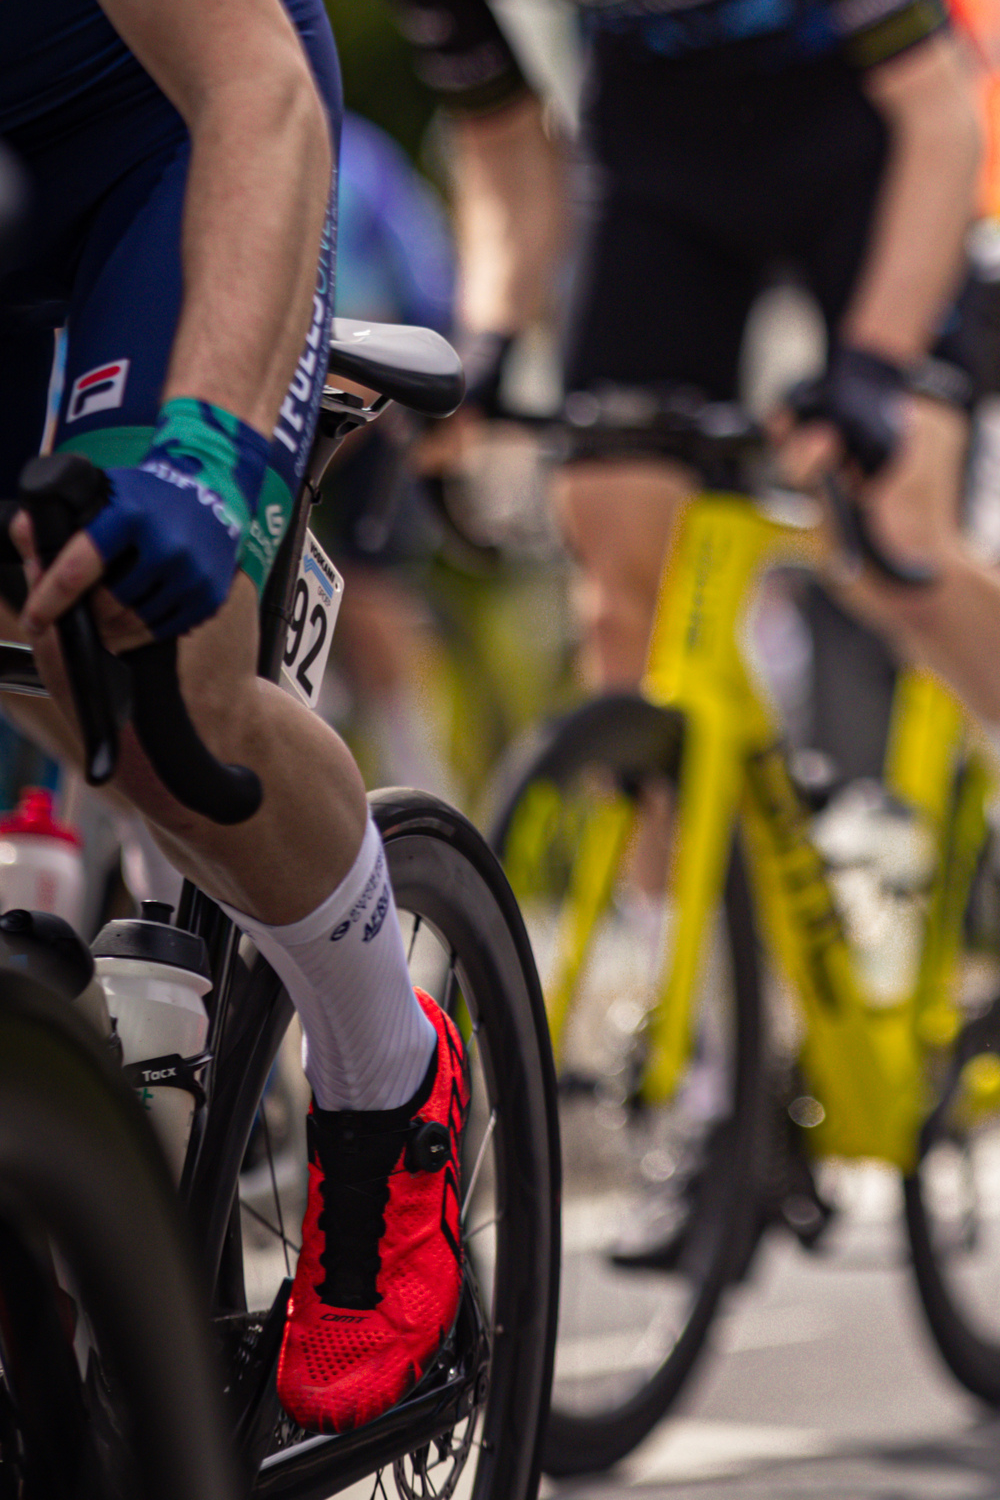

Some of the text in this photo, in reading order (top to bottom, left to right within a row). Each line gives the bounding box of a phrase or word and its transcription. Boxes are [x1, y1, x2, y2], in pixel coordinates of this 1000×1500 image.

[283, 577, 328, 699] 92
[141, 1067, 177, 1082] Tacx
[319, 1313, 370, 1325] DMT
